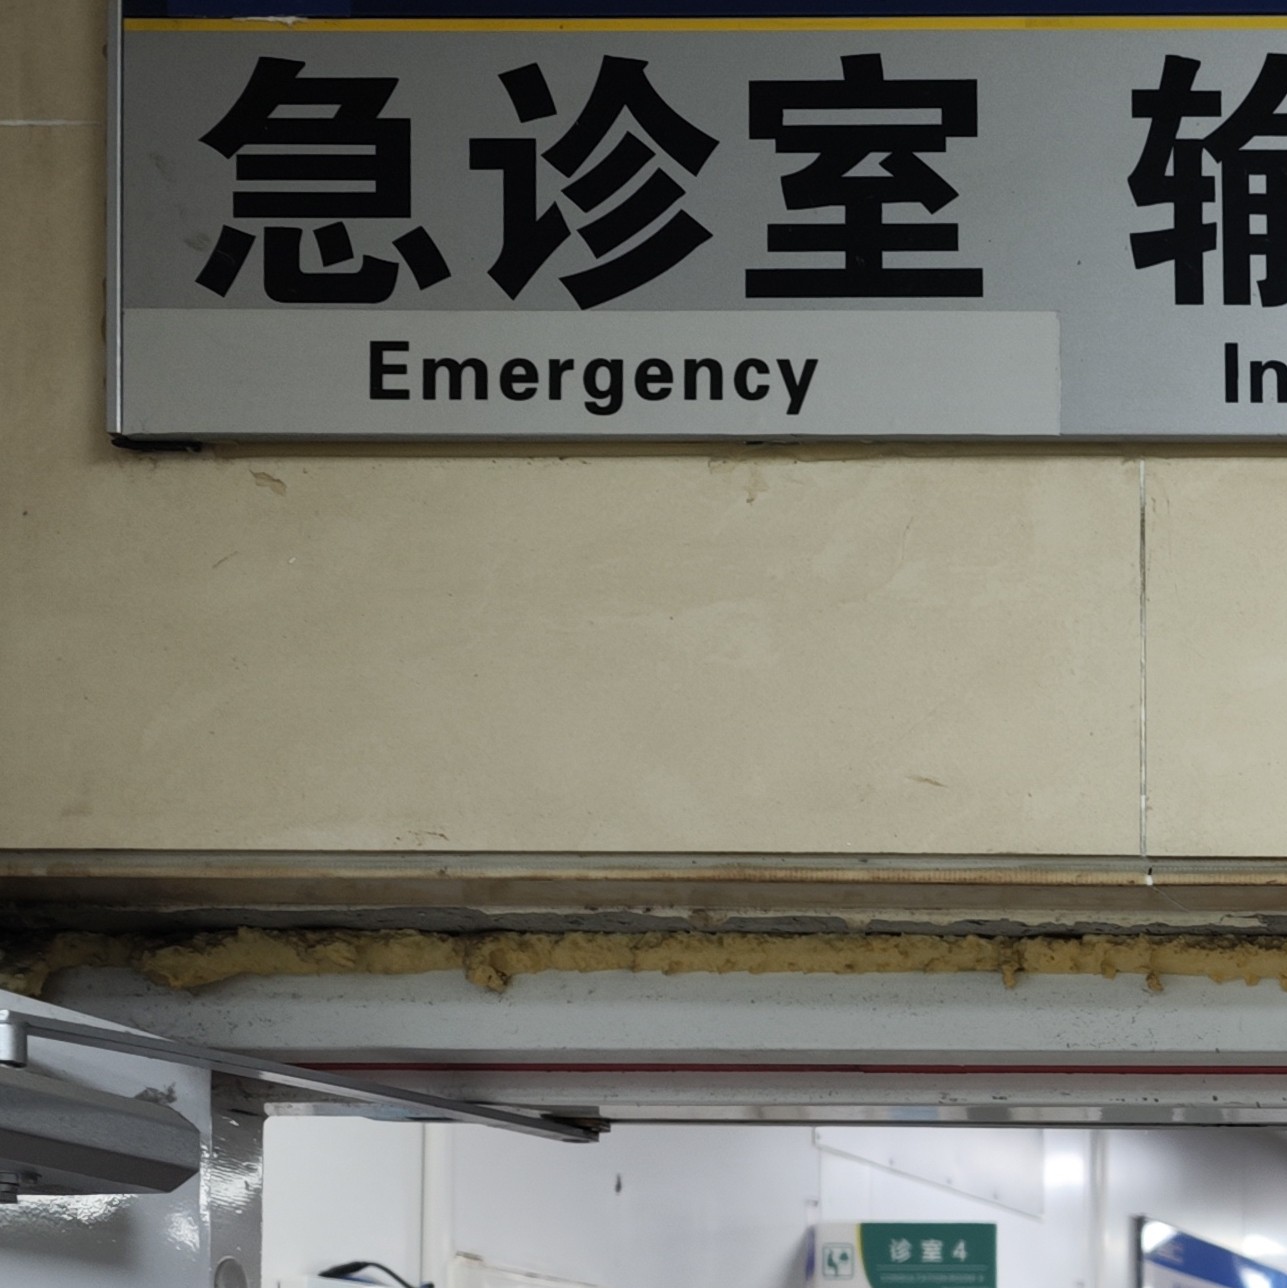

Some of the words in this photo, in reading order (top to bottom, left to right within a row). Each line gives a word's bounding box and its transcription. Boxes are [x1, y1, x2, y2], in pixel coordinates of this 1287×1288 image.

[195, 53, 983, 310] 急诊室
[368, 340, 819, 415] Emergency
